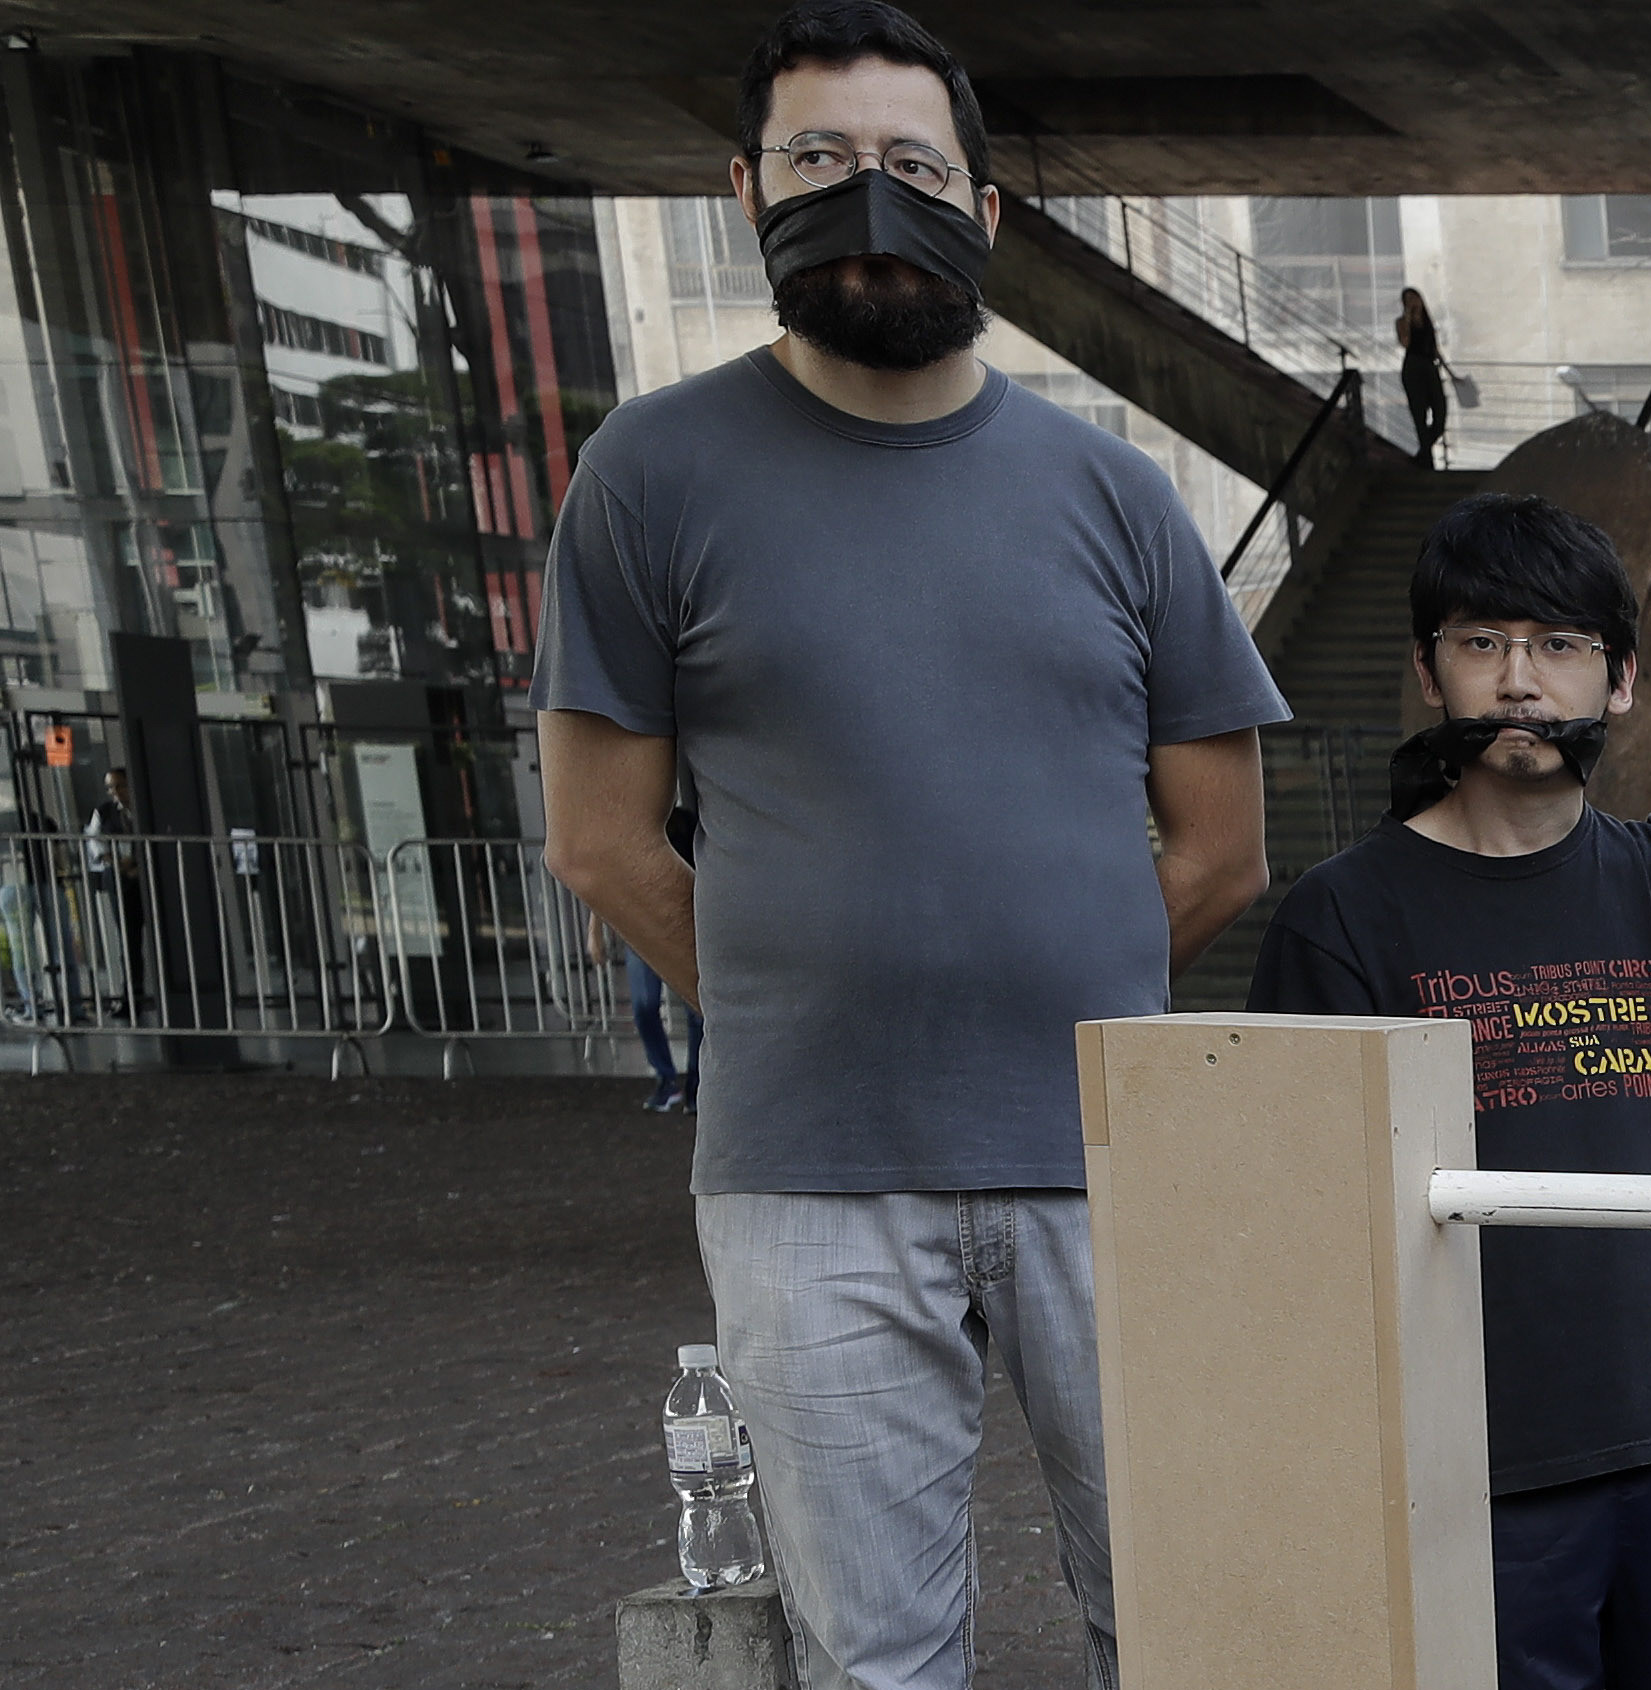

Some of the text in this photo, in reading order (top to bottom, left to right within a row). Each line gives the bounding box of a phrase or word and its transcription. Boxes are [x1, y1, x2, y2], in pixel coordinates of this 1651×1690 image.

[1530, 961, 1573, 980] TRIBUS
[1575, 960, 1607, 977] POINT
[1411, 969, 1515, 1005] Tribus
[1452, 1000, 1512, 1018] STREET
[1513, 997, 1649, 1028] MOSTRE
[1516, 1040, 1567, 1055] ALMAS
[1568, 1034, 1601, 1049] SUA
[1561, 1078, 1619, 1101] artes
